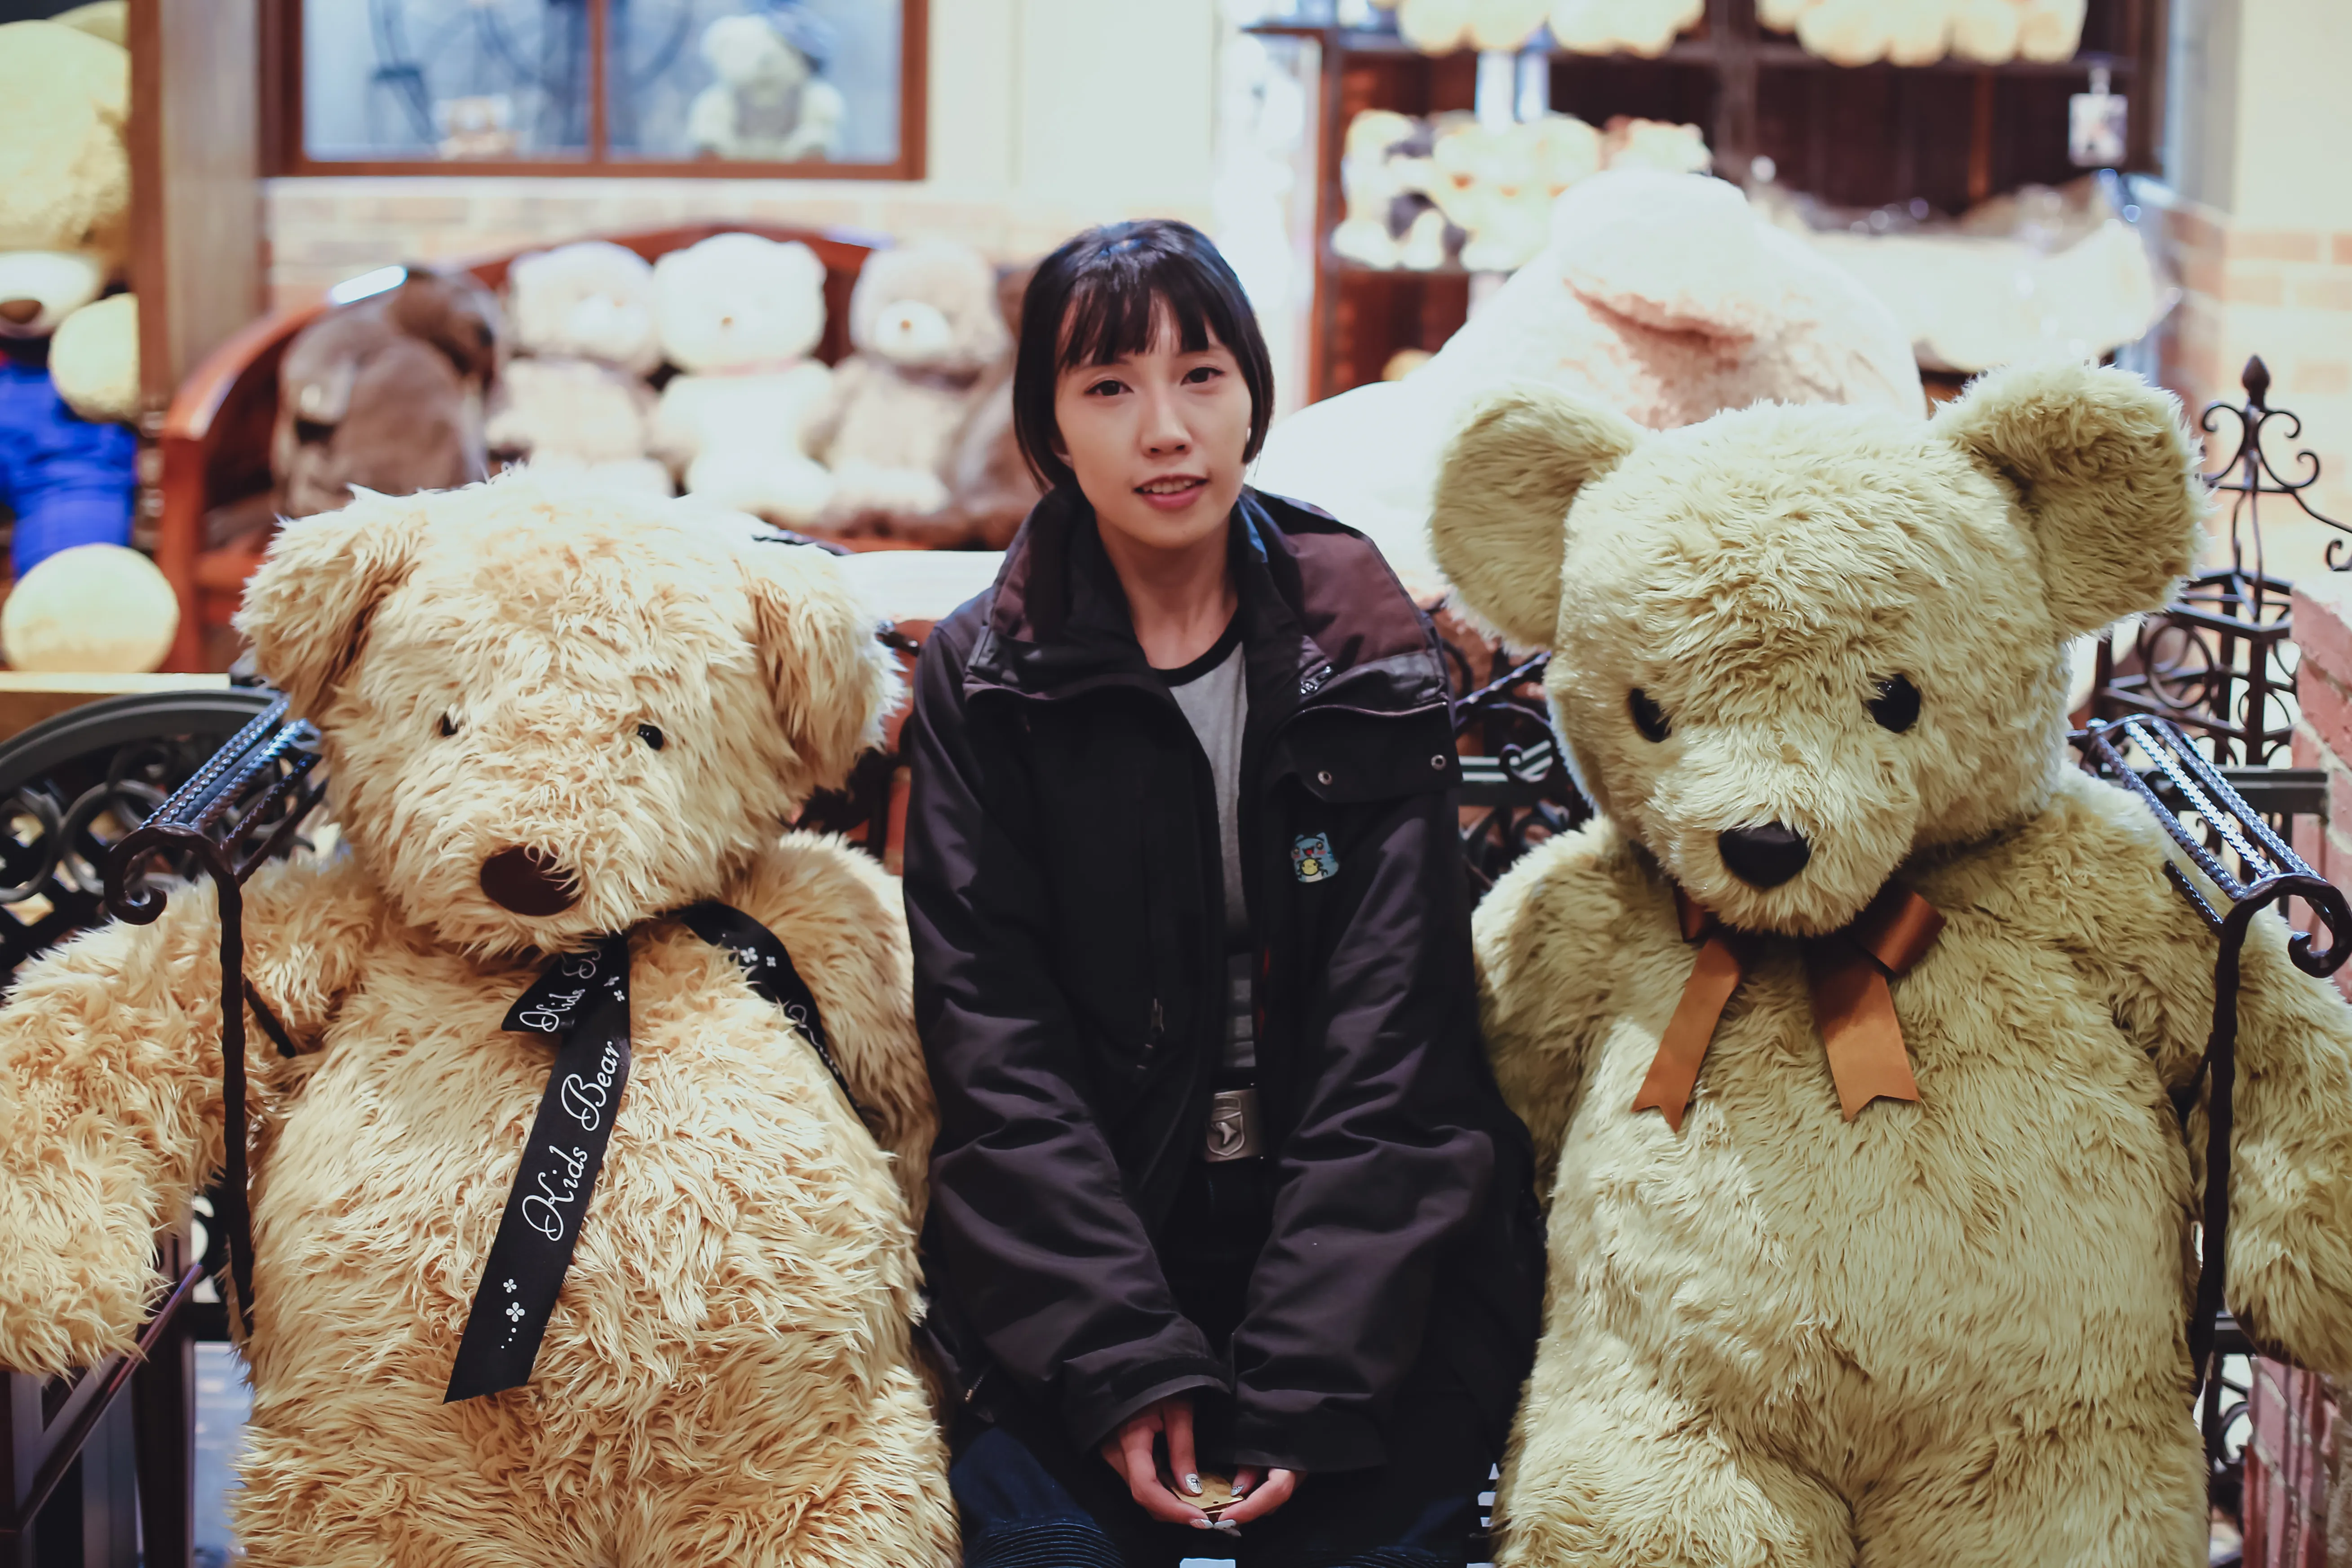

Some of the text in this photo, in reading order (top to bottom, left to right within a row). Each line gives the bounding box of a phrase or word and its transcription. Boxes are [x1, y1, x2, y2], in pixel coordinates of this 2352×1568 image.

[519, 988, 585, 1032] Kids
[522, 1145, 588, 1241] Kids
[561, 1041, 620, 1131] Bear
